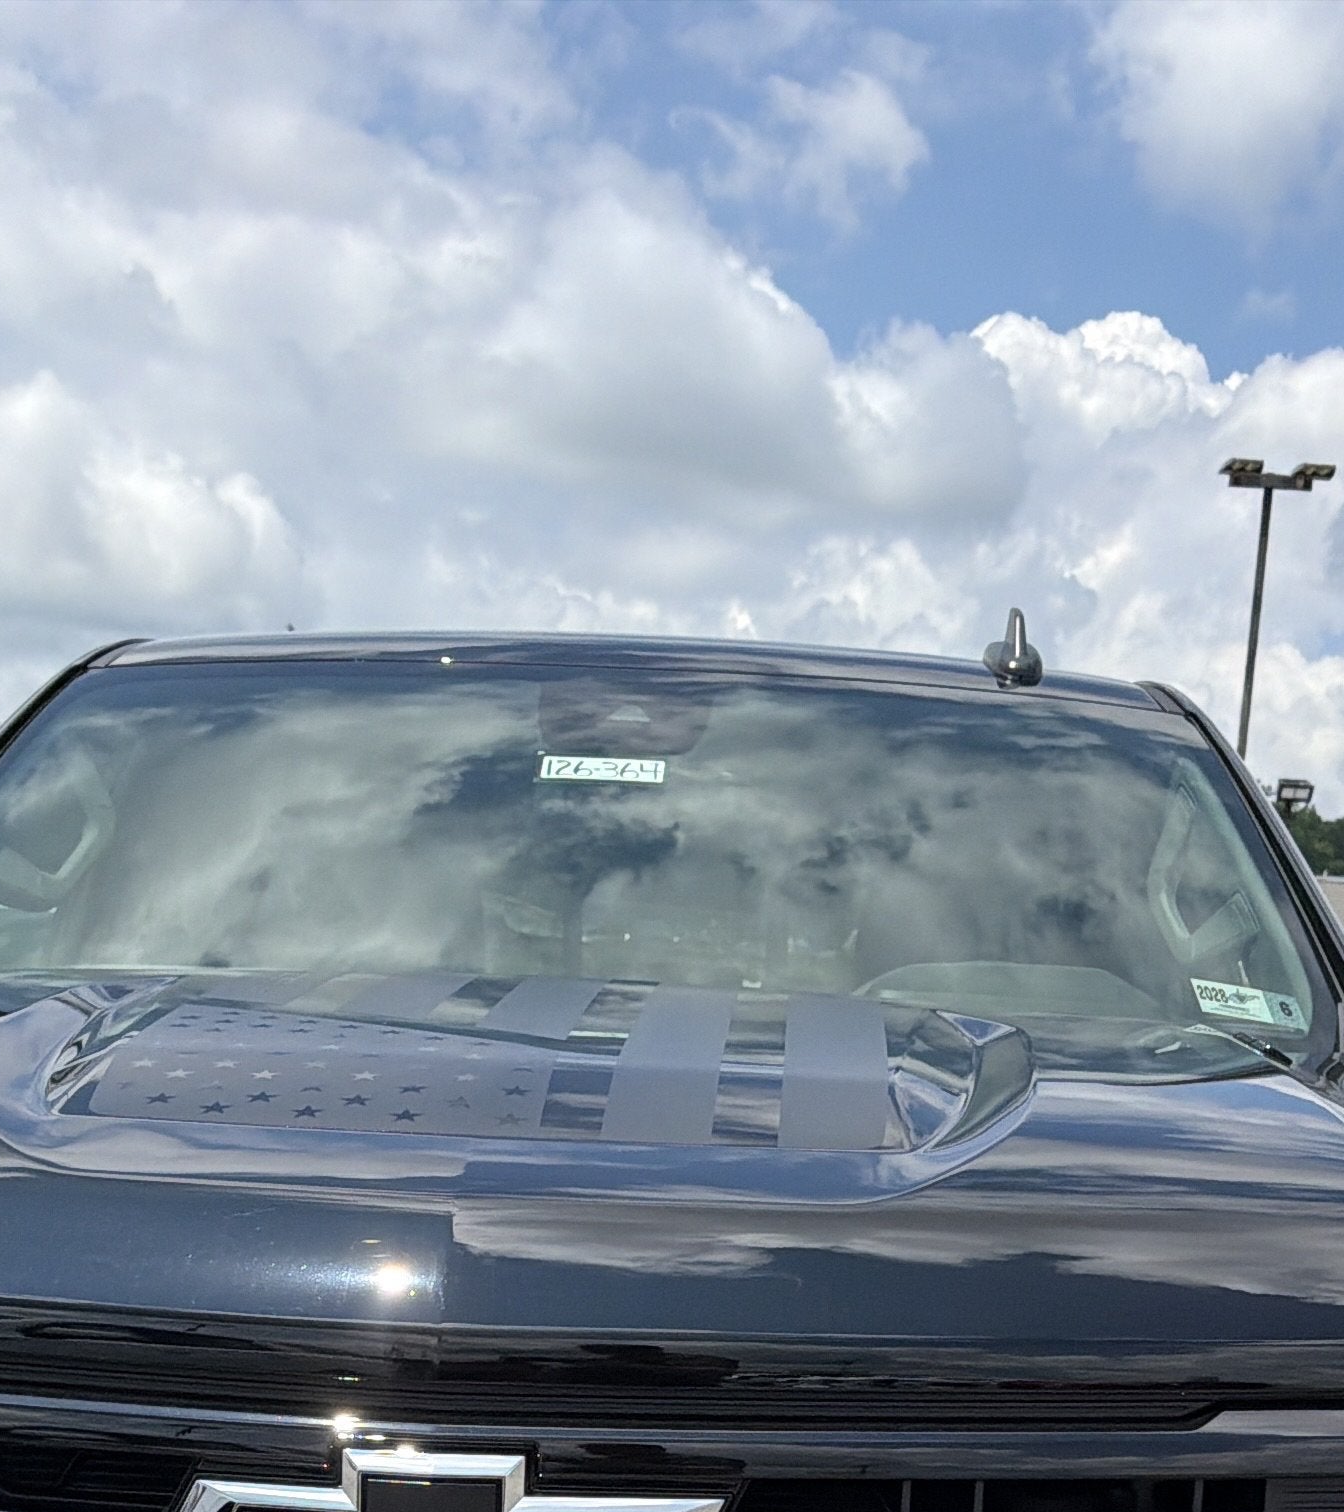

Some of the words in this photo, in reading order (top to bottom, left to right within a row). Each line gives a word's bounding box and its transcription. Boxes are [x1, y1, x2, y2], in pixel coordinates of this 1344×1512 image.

[546, 759, 662, 781] 126-364
[1196, 985, 1229, 1003] 2028
[1278, 1001, 1293, 1017] 6
